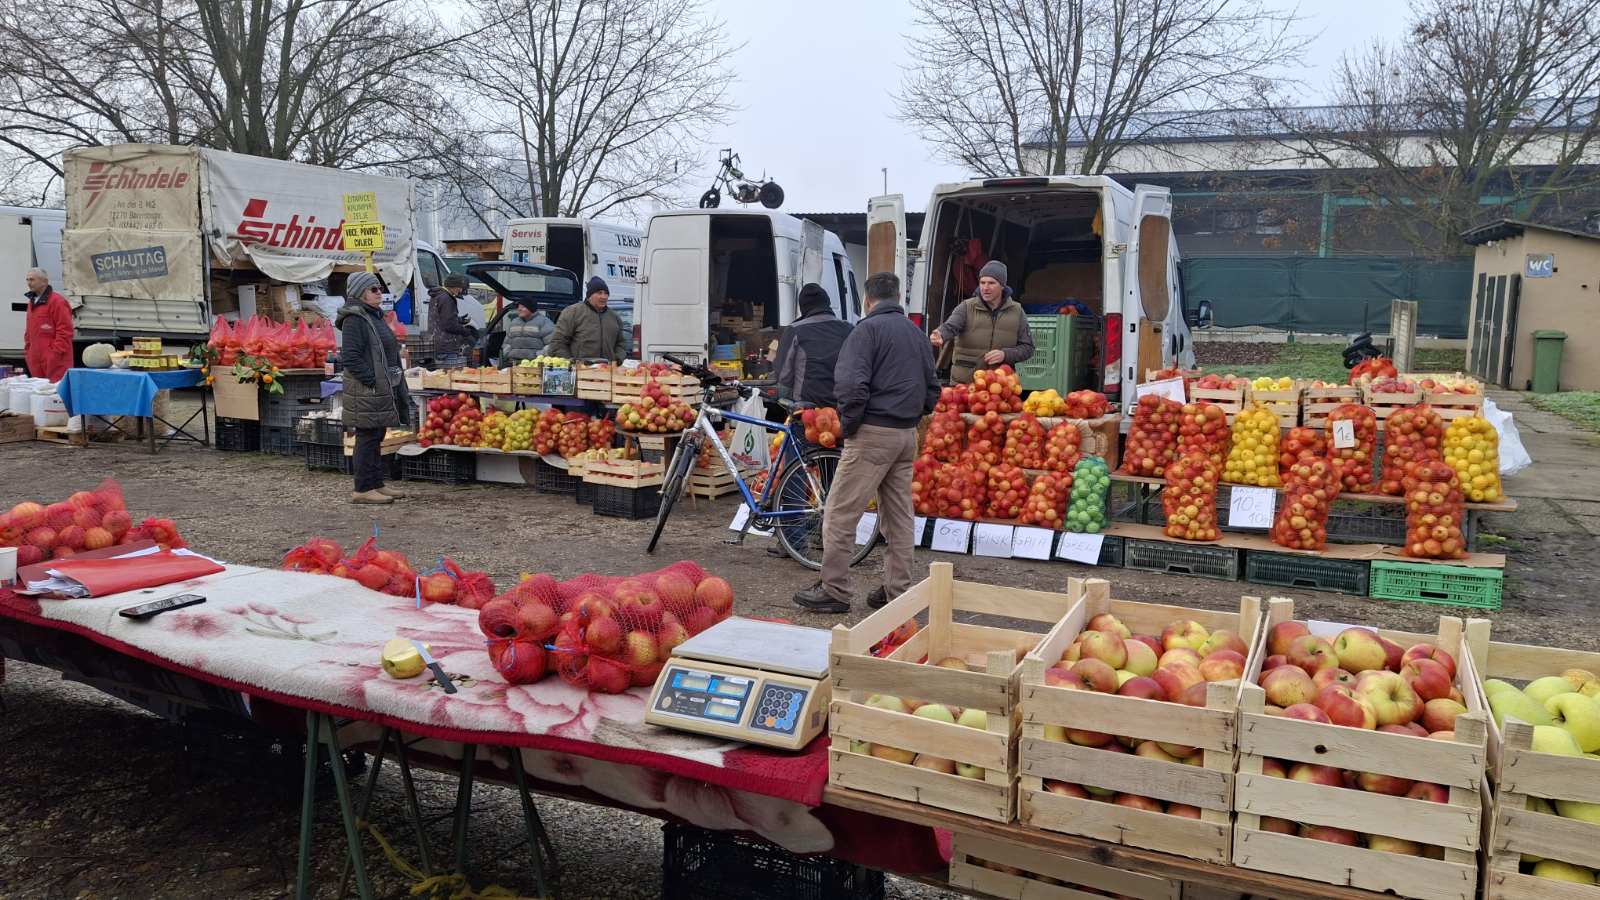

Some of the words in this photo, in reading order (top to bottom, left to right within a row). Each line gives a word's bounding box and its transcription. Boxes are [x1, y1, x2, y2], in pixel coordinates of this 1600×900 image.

[83, 162, 190, 201] Schindele
[512, 229, 542, 238] Servis
[531, 245, 545, 253] THE
[95, 250, 165, 271] SCHAUTAG
[1529, 260, 1550, 271] WC
